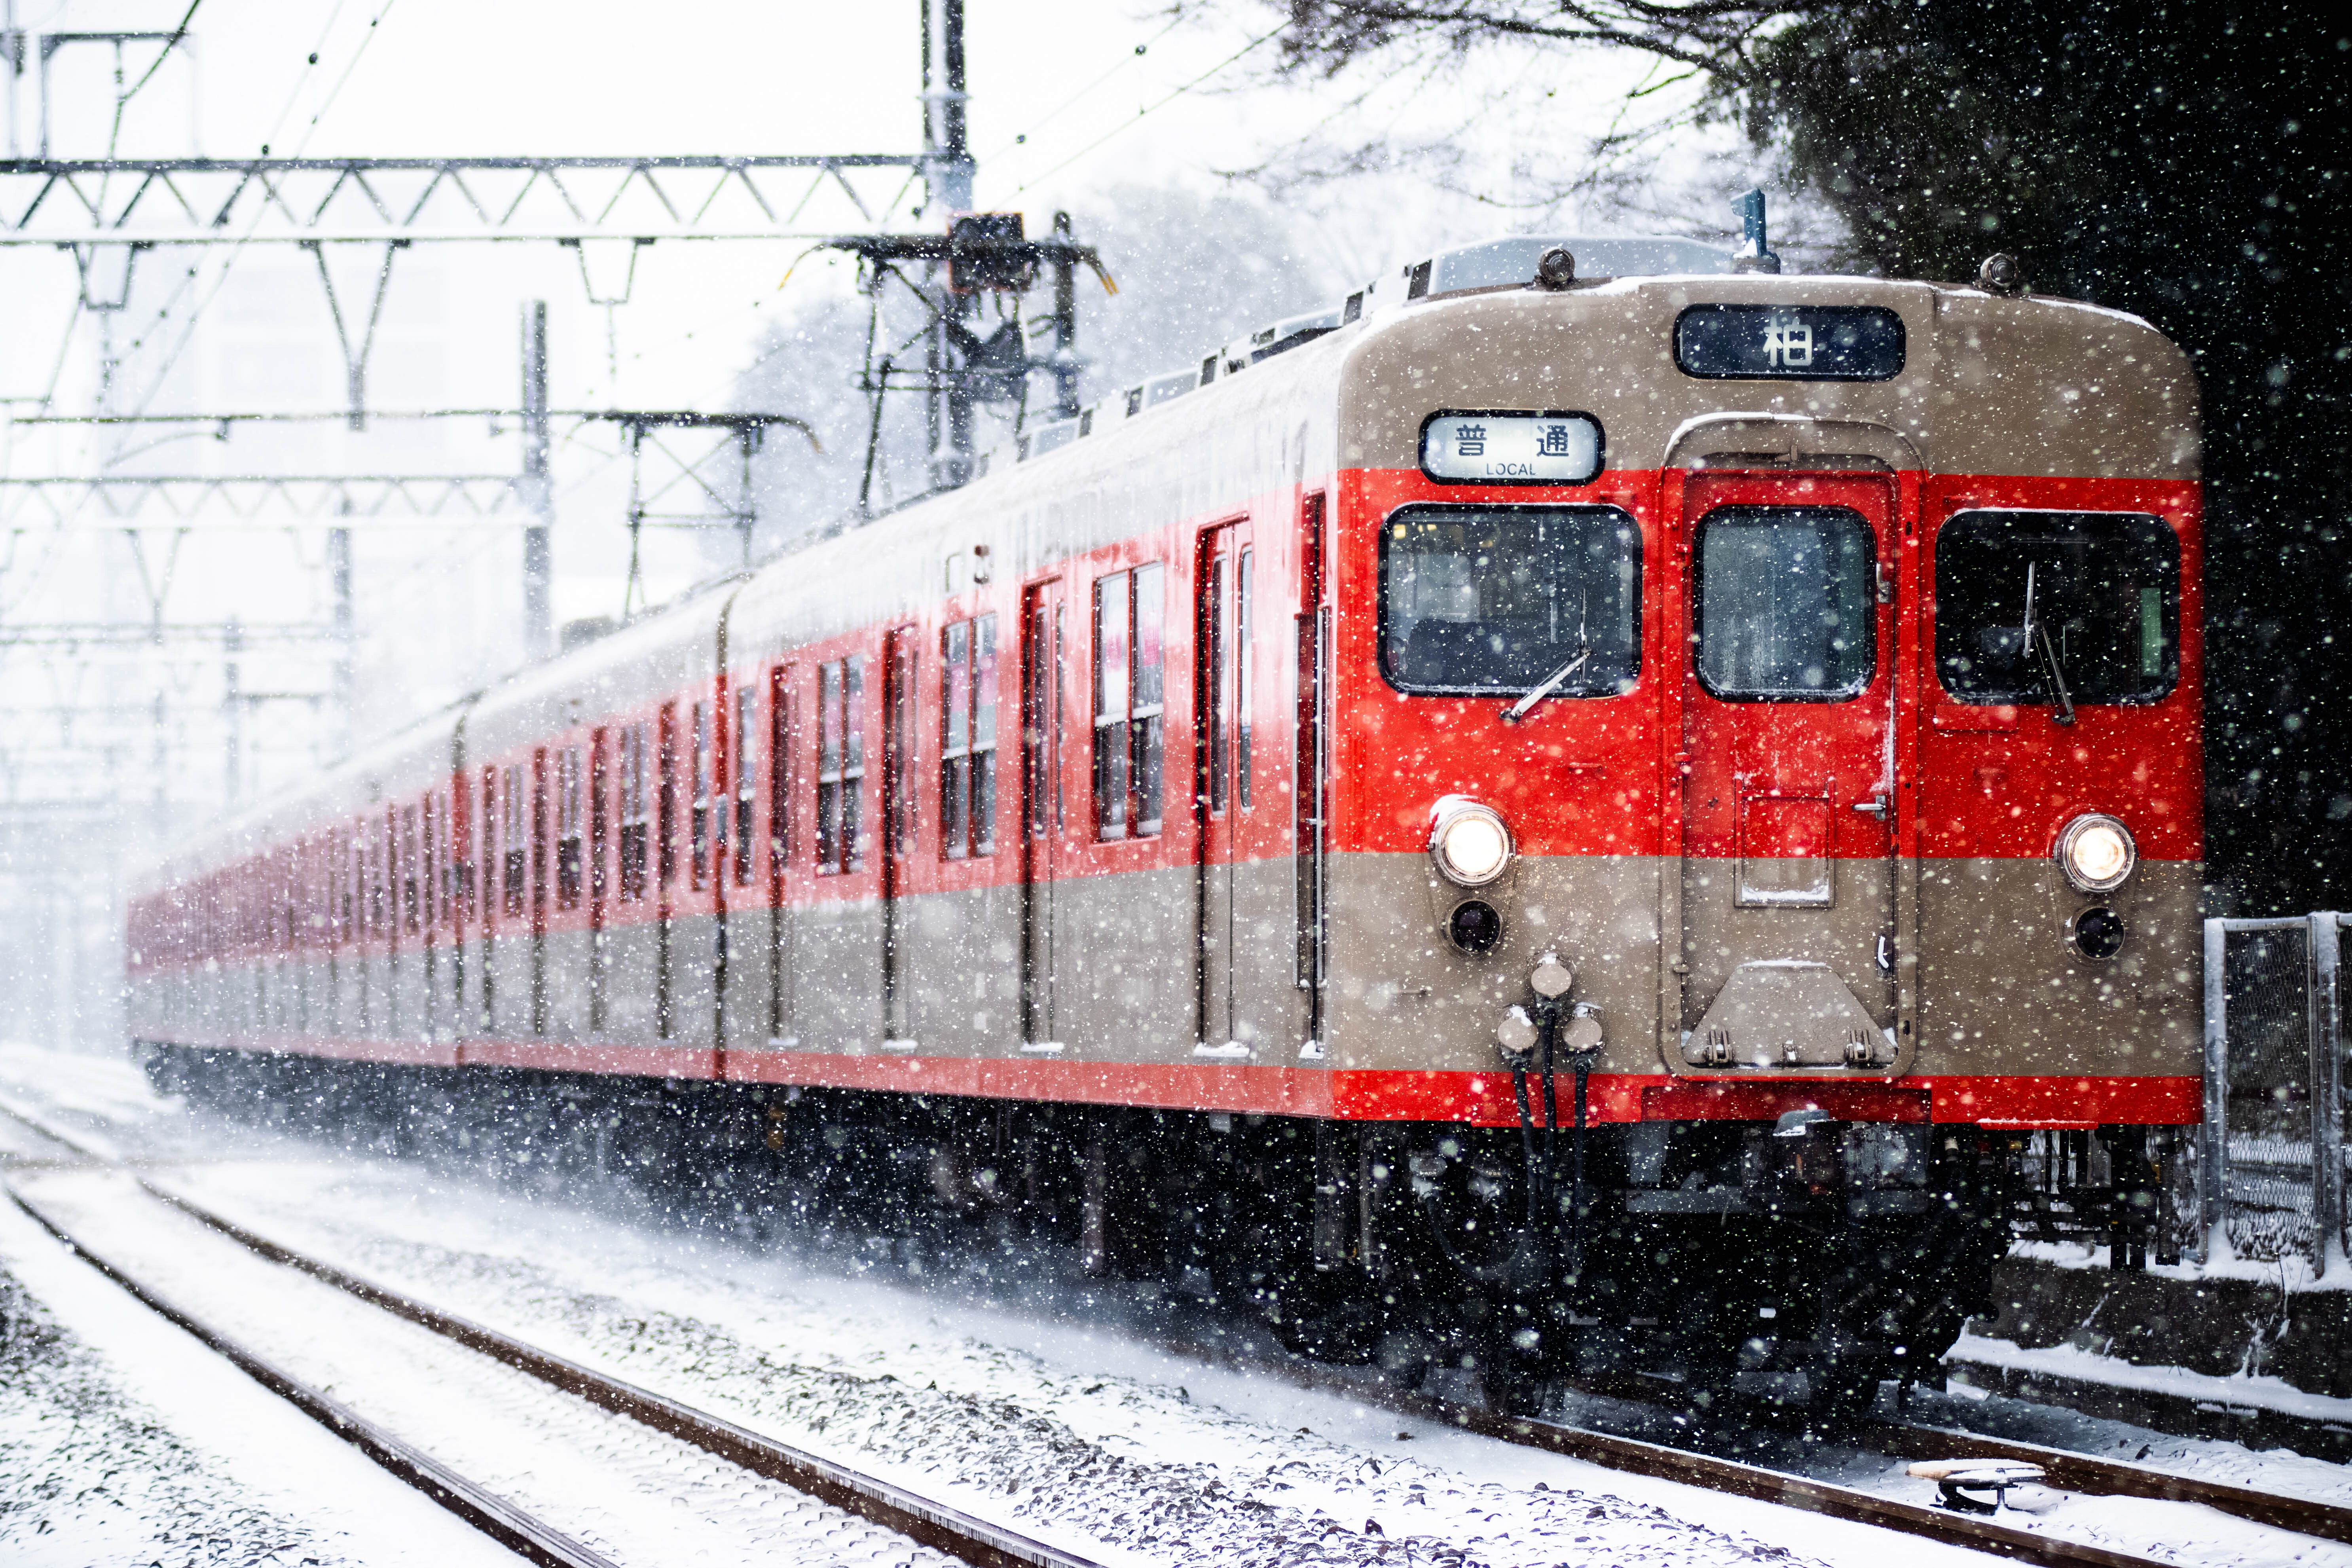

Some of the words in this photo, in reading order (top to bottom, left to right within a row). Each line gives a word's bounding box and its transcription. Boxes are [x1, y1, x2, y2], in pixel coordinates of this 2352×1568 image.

[1763, 316, 1812, 367] 柏
[1455, 424, 1569, 457] 普通
[1486, 463, 1537, 475] LOCAL
